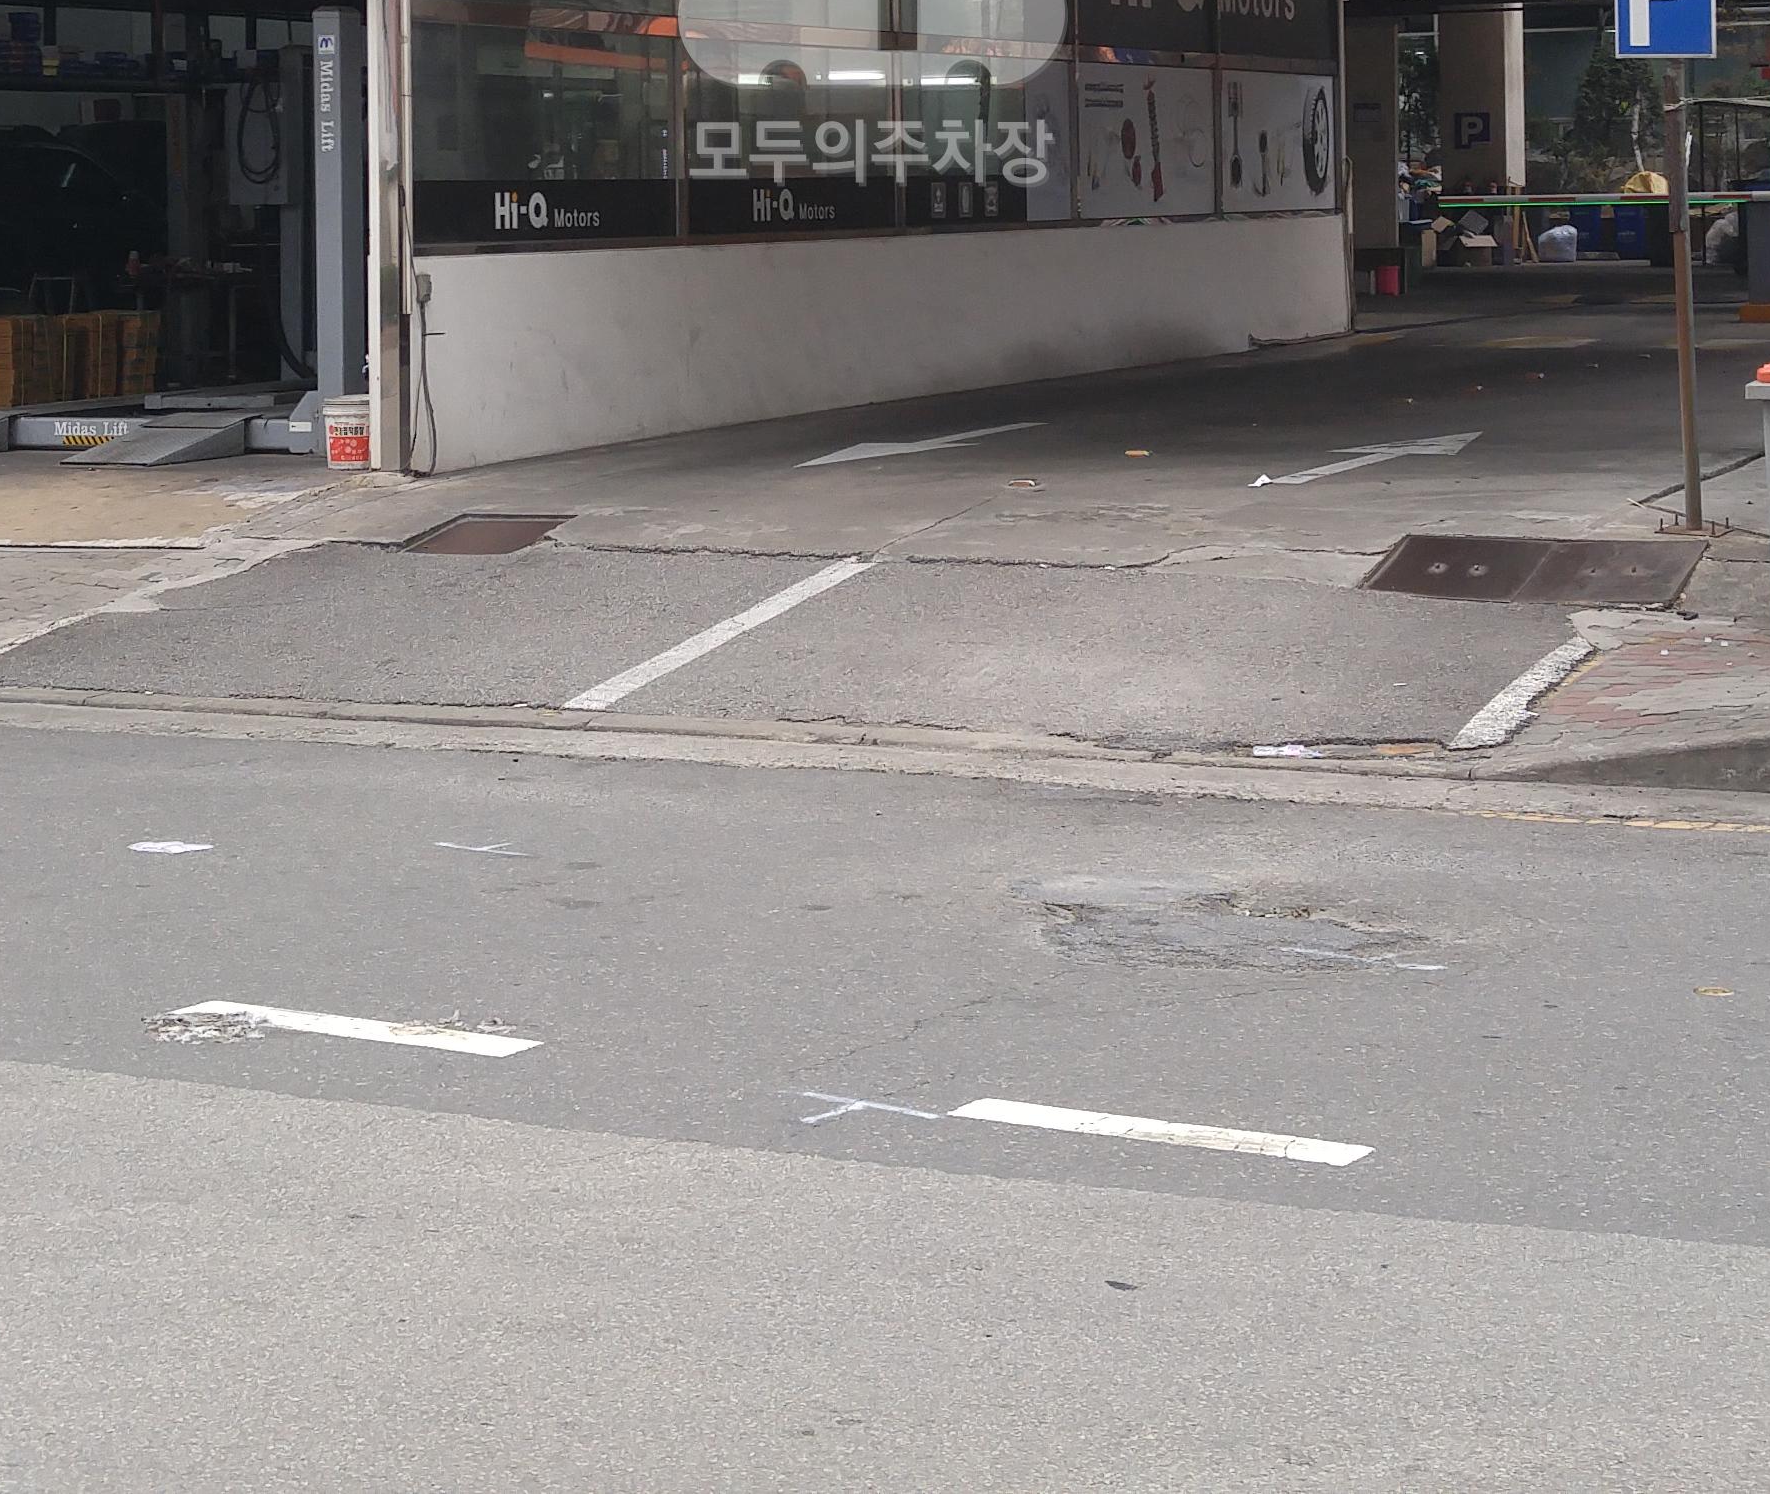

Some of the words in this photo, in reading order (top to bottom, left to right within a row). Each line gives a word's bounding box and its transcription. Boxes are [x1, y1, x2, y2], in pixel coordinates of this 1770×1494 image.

[1460, 116, 1483, 145] P
[493, 190, 549, 230] Hi-Q
[554, 207, 601, 230] Motors
[752, 187, 795, 223] Hi-Q
[799, 202, 836, 222] Motors
[53, 421, 97, 437] Midas
